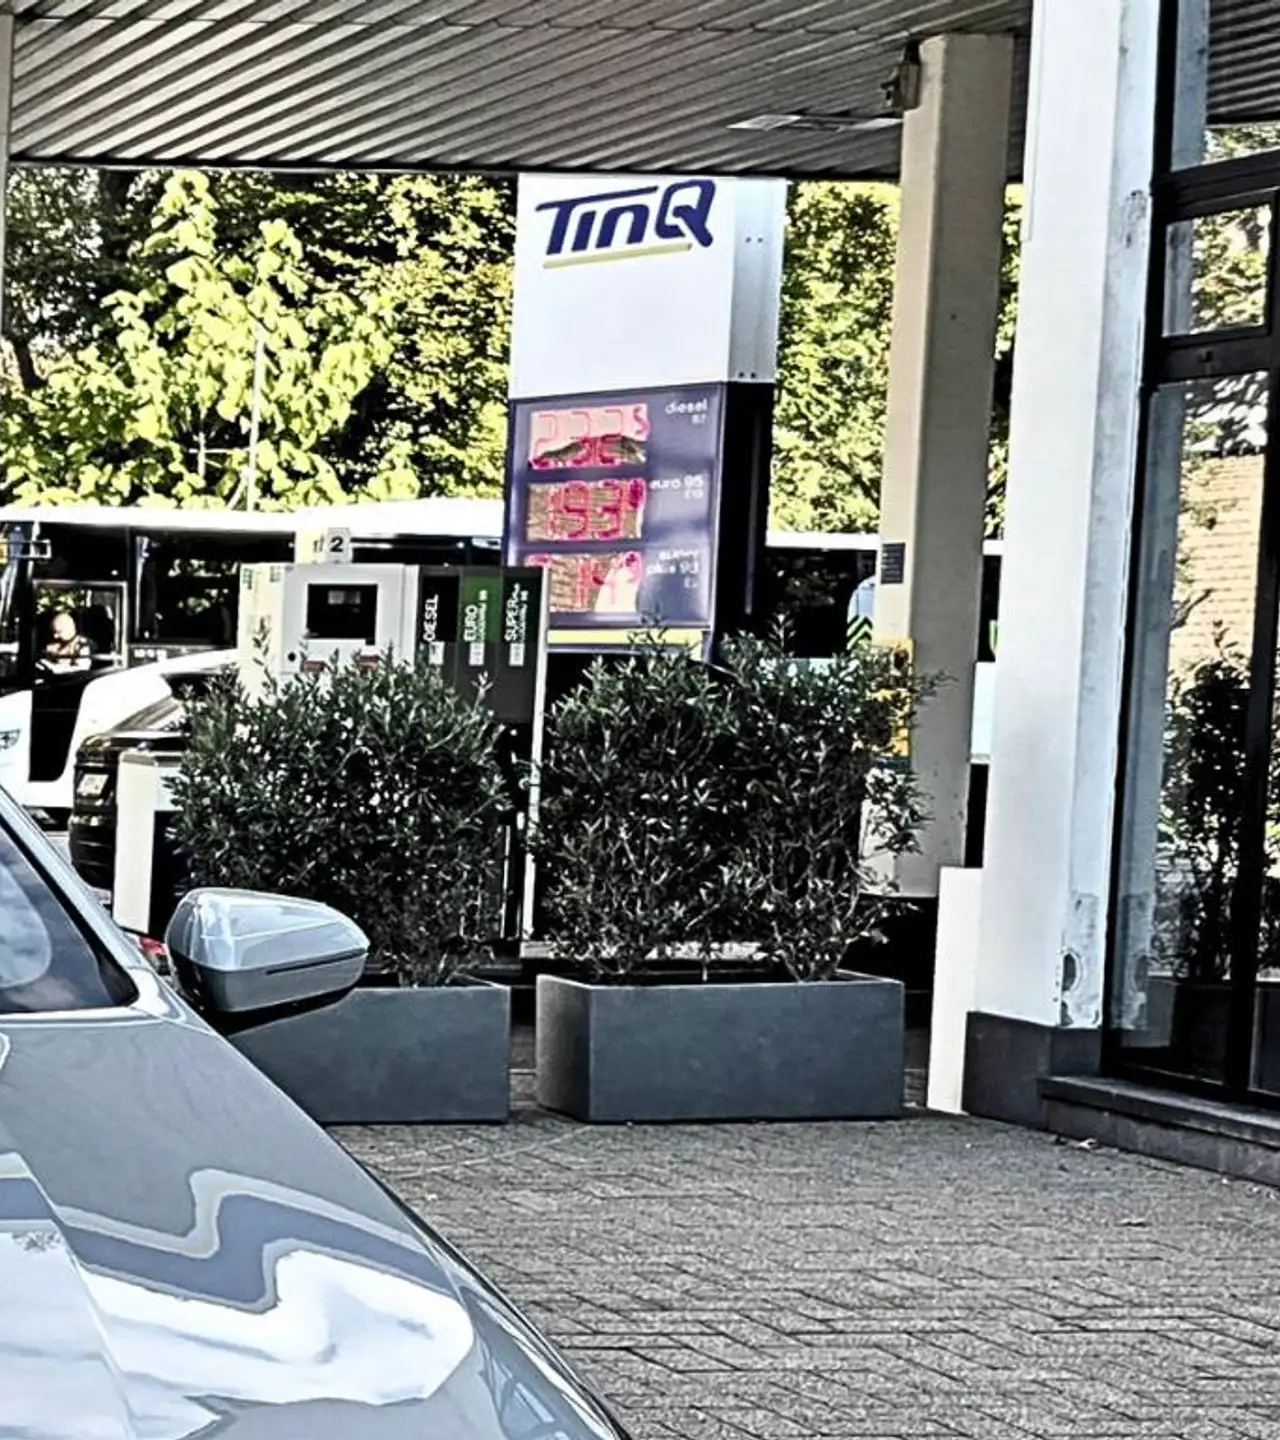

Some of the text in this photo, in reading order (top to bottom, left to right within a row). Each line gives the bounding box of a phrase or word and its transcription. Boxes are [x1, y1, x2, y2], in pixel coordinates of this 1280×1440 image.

[665, 399, 707, 414] diesel
[649, 478, 682, 490] euro
[329, 536, 344, 553] 2
[423, 594, 439, 641] DIESEL
[463, 604, 478, 641] EURO
